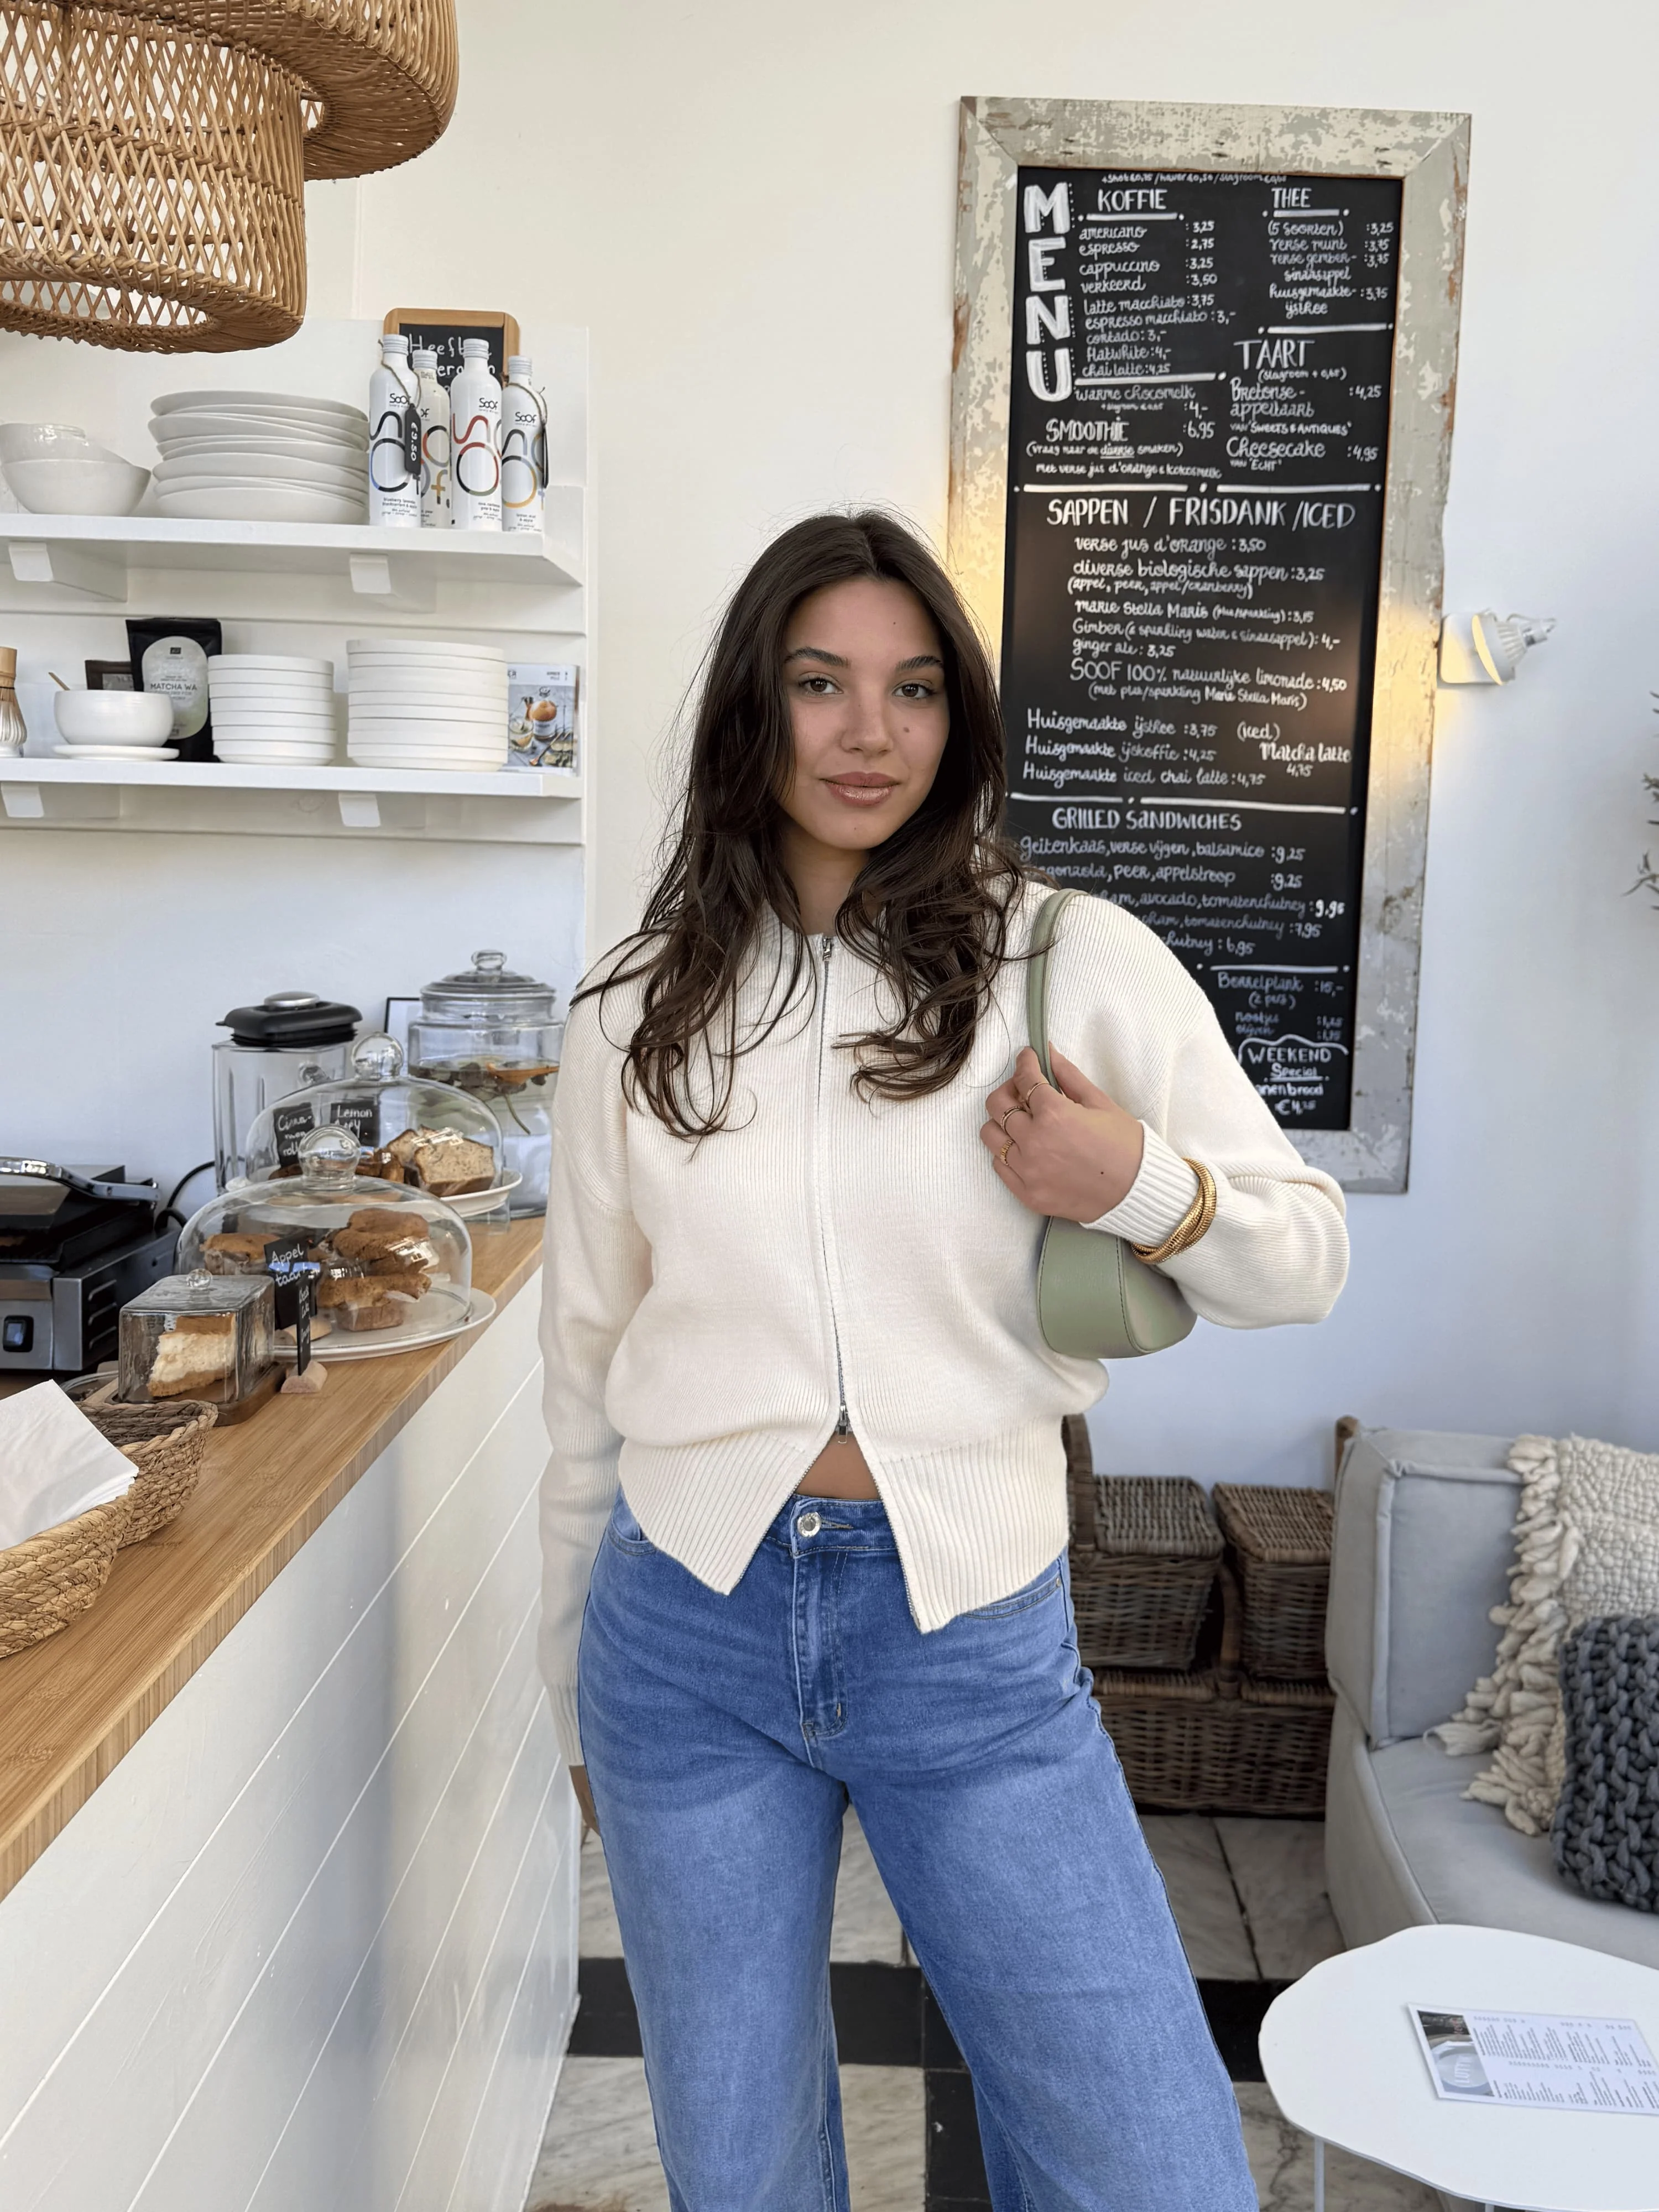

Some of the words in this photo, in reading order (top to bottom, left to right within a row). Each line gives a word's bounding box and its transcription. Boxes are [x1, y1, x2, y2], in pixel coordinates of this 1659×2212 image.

[1098, 189, 1168, 212] KOFFIE
[1271, 187, 1312, 208] THEE
[1078, 226, 1147, 240] americano
[1078, 242, 1140, 260] espresso
[1079, 261, 1161, 279] cappuccino
[1084, 299, 1117, 315] latte
[1086, 316, 1142, 333] espresso
[1233, 339, 1315, 370] TAART
[1226, 436, 1326, 459] Cheesecake
[1046, 497, 1129, 526] SAPPEN
[1142, 495, 1158, 528] /
[1169, 496, 1287, 527] FRISDANK
[1074, 536, 1118, 552] verse
[1120, 536, 1149, 560] jus
[1073, 559, 1133, 576] diverse
[1070, 658, 1123, 681] SOOF
[1127, 664, 1167, 682] 100%
[1052, 807, 1121, 830] GRILLED
[1248, 1047, 1331, 1064] WEEKEND
[1270, 1063, 1317, 1078] Special
[337, 1105, 373, 1118] Lemon
[272, 1243, 304, 1266] Appel
